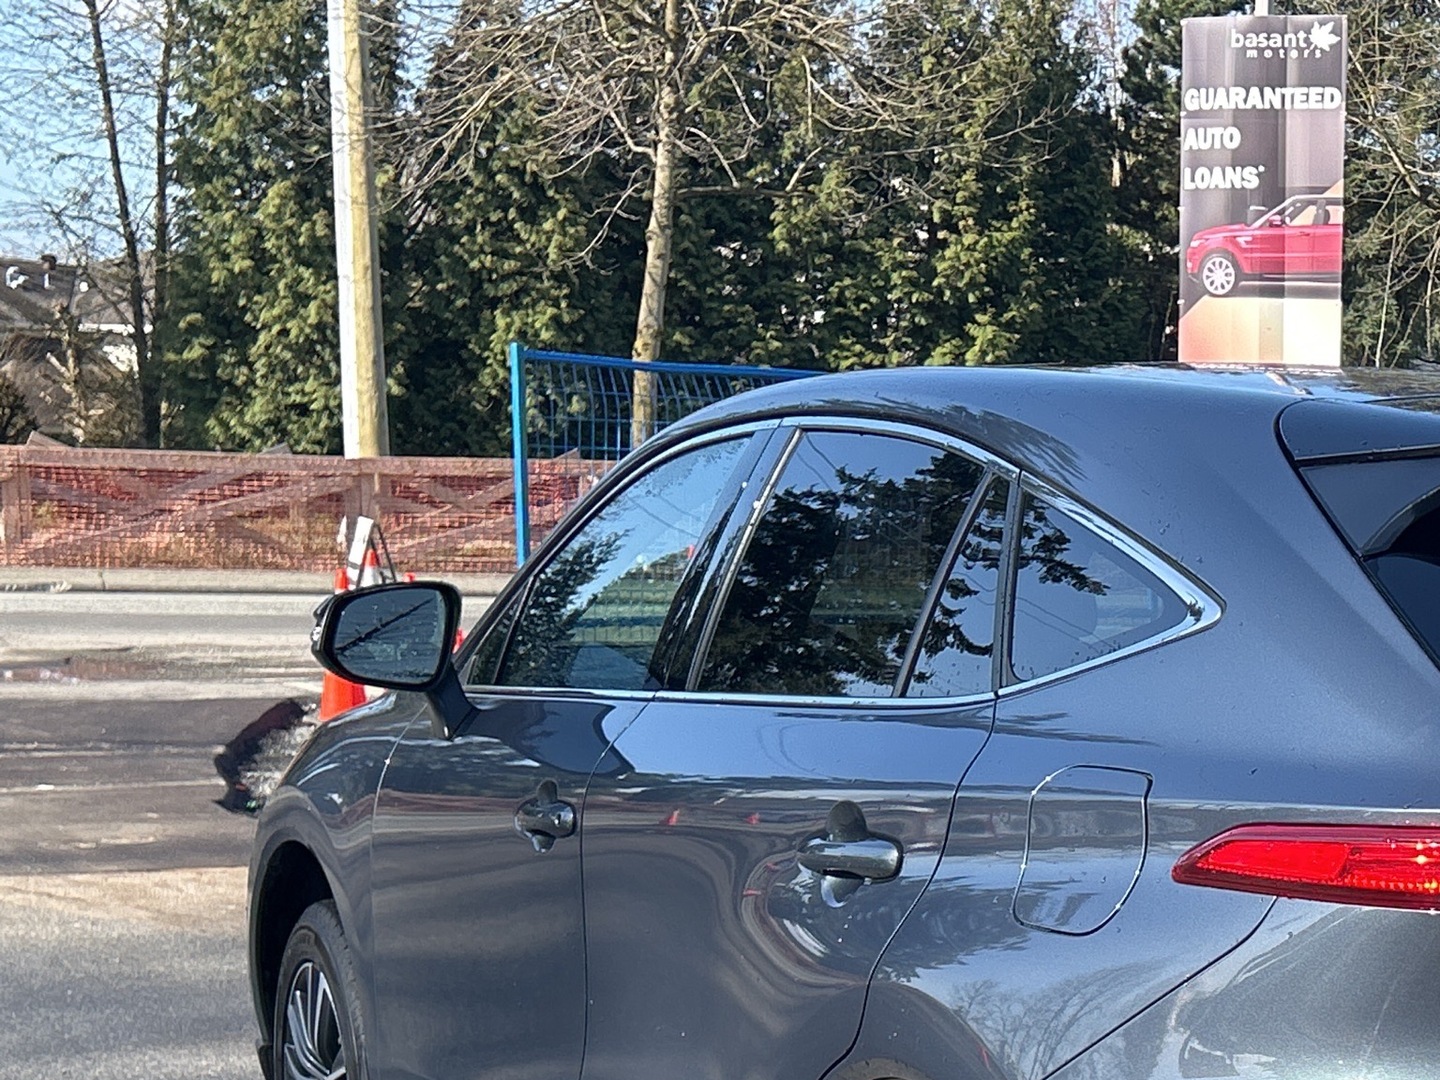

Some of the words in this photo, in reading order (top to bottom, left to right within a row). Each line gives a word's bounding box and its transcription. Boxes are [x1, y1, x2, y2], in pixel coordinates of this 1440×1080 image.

[1230, 28, 1308, 49] basant
[1245, 49, 1322, 59] motors
[1184, 86, 1342, 111] GUARANTEED
[1184, 126, 1241, 151] AUTO
